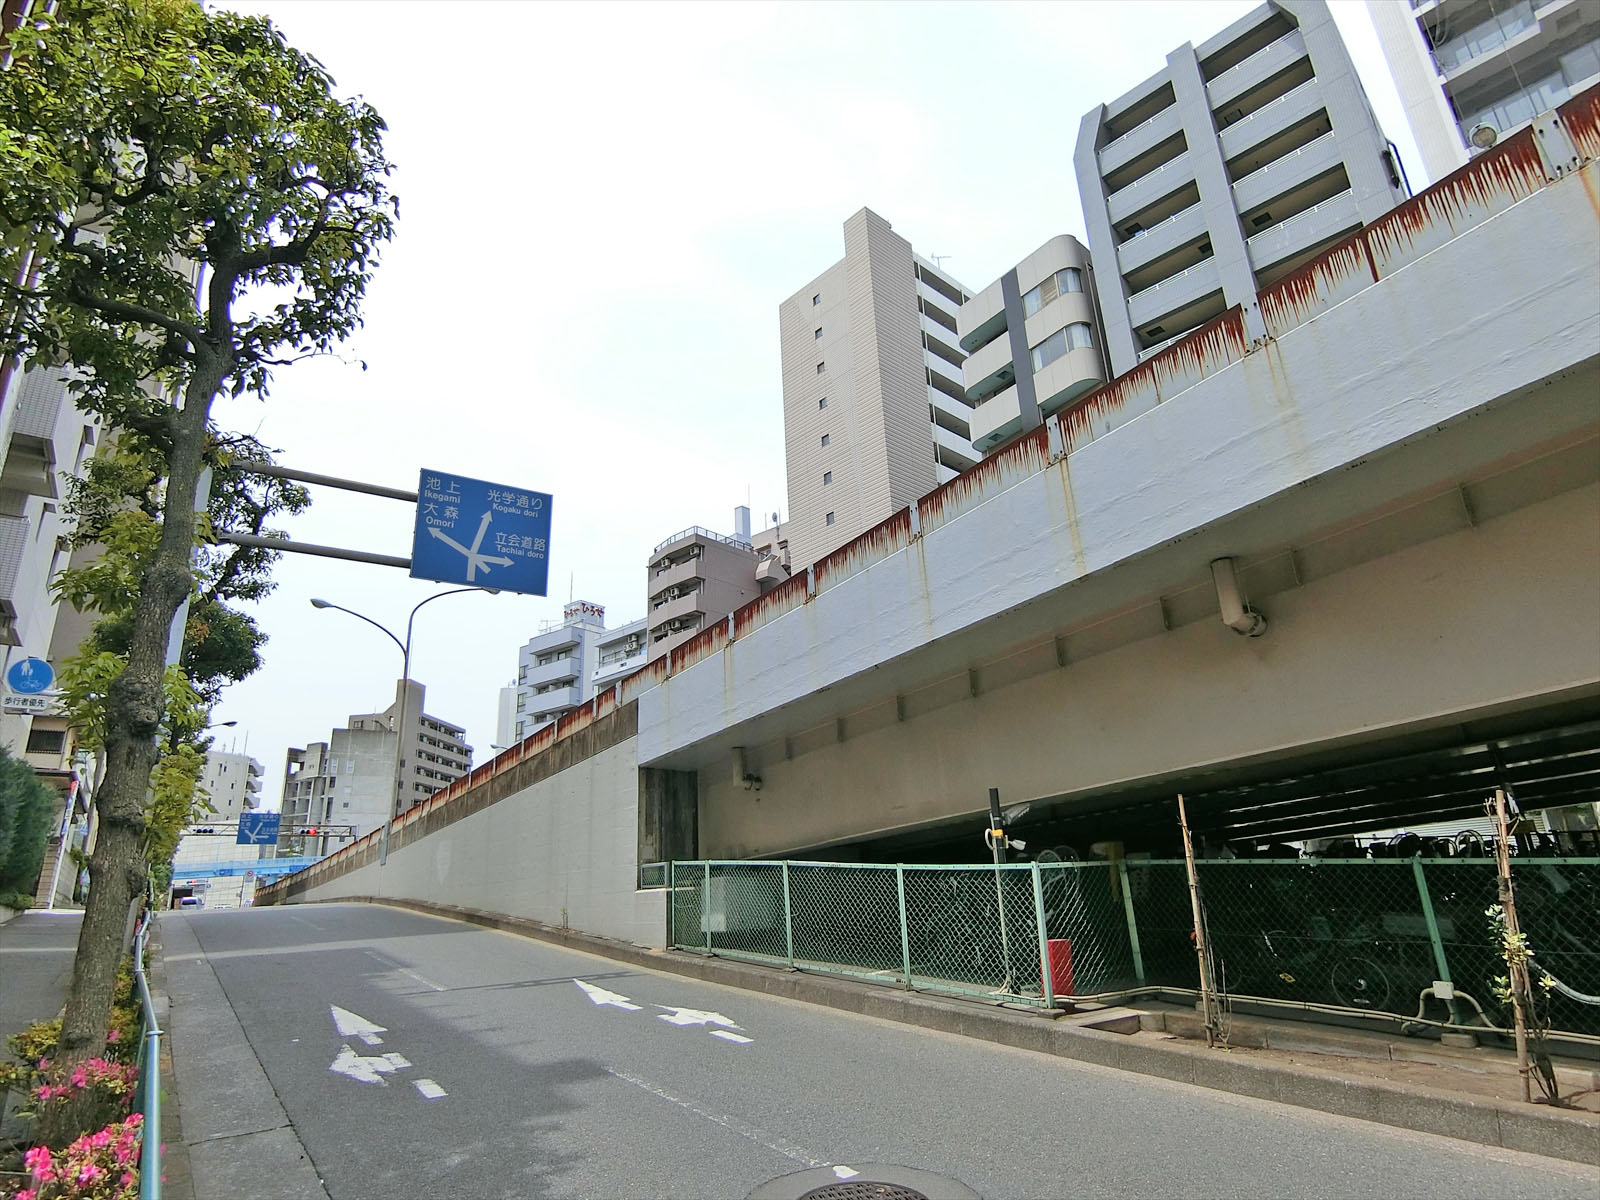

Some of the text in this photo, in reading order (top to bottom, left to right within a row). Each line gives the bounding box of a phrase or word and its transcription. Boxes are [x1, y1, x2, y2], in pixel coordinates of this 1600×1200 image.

[425, 476, 461, 495] 池上
[425, 489, 461, 504] Ikegami
[487, 489, 543, 510] 光学通り
[423, 502, 459, 520] 大森
[492, 503, 539, 518] Kogaku dori
[425, 516, 454, 528] Omori
[494, 532, 546, 552] 立会道路
[496, 545, 545, 560] Tachiai doro
[582, 603, 604, 617] ひろせ
[5, 697, 45, 707] 歩行者優先
